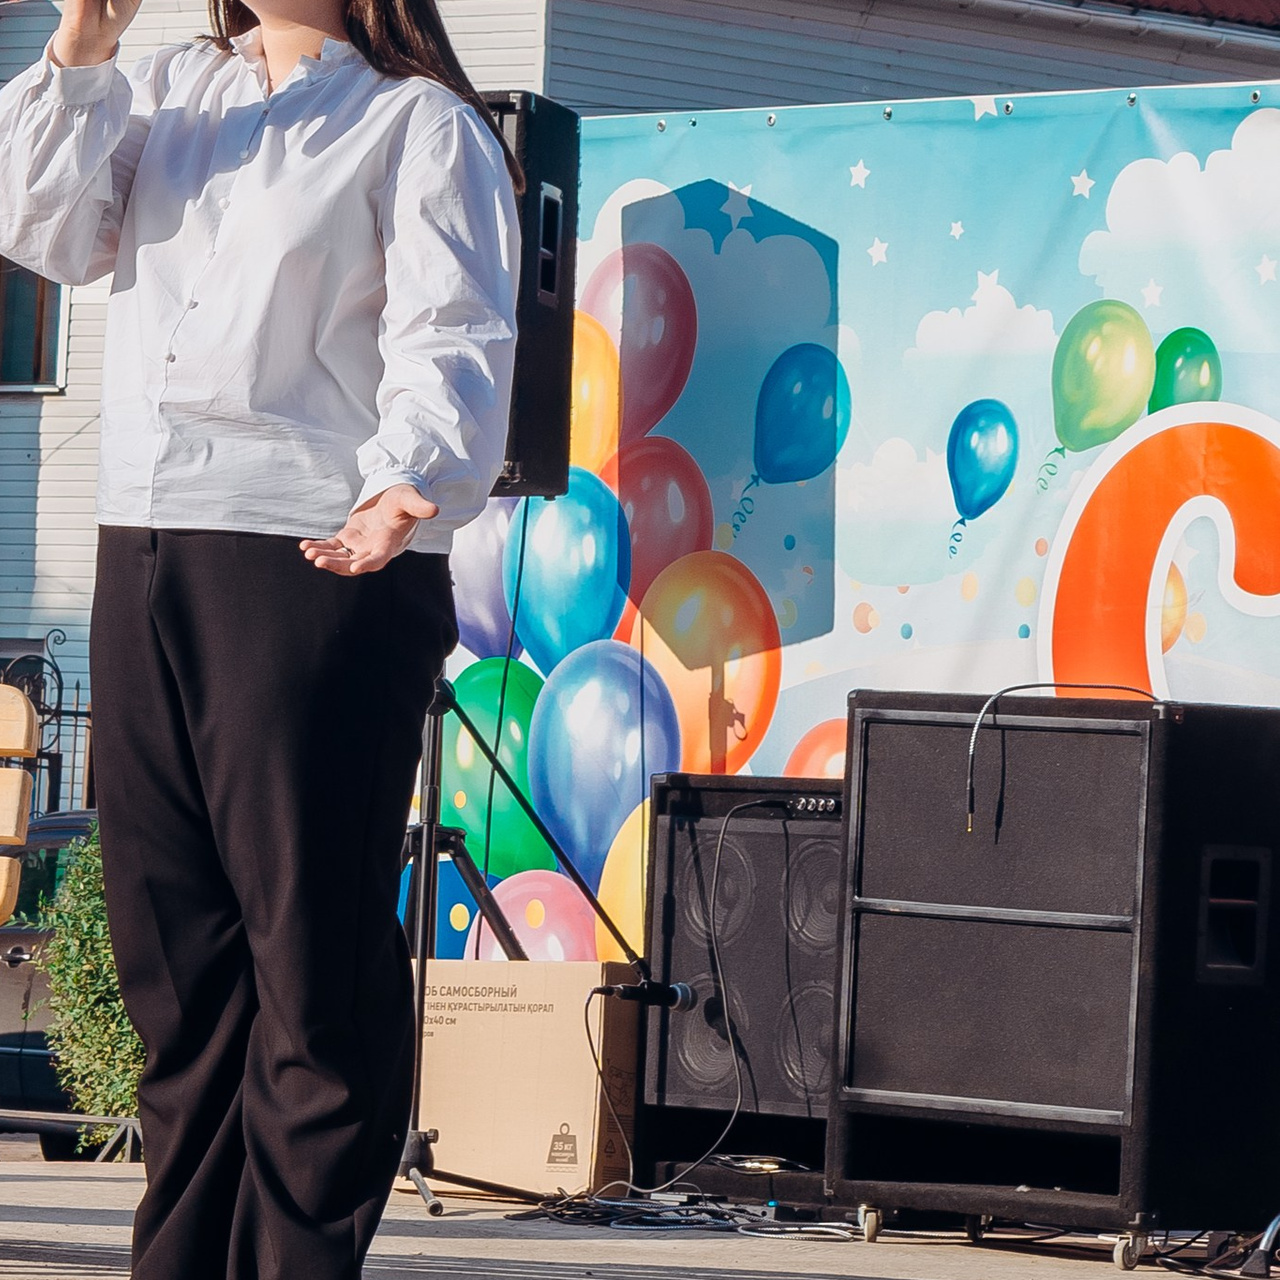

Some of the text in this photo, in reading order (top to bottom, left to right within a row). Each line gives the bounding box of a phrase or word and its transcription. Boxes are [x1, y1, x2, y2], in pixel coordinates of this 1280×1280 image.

[424, 985, 518, 998] ОБ САМОСБОРНЫЙ
[445, 1016, 457, 1025] см
[553, 1141, 564, 1151] 35
